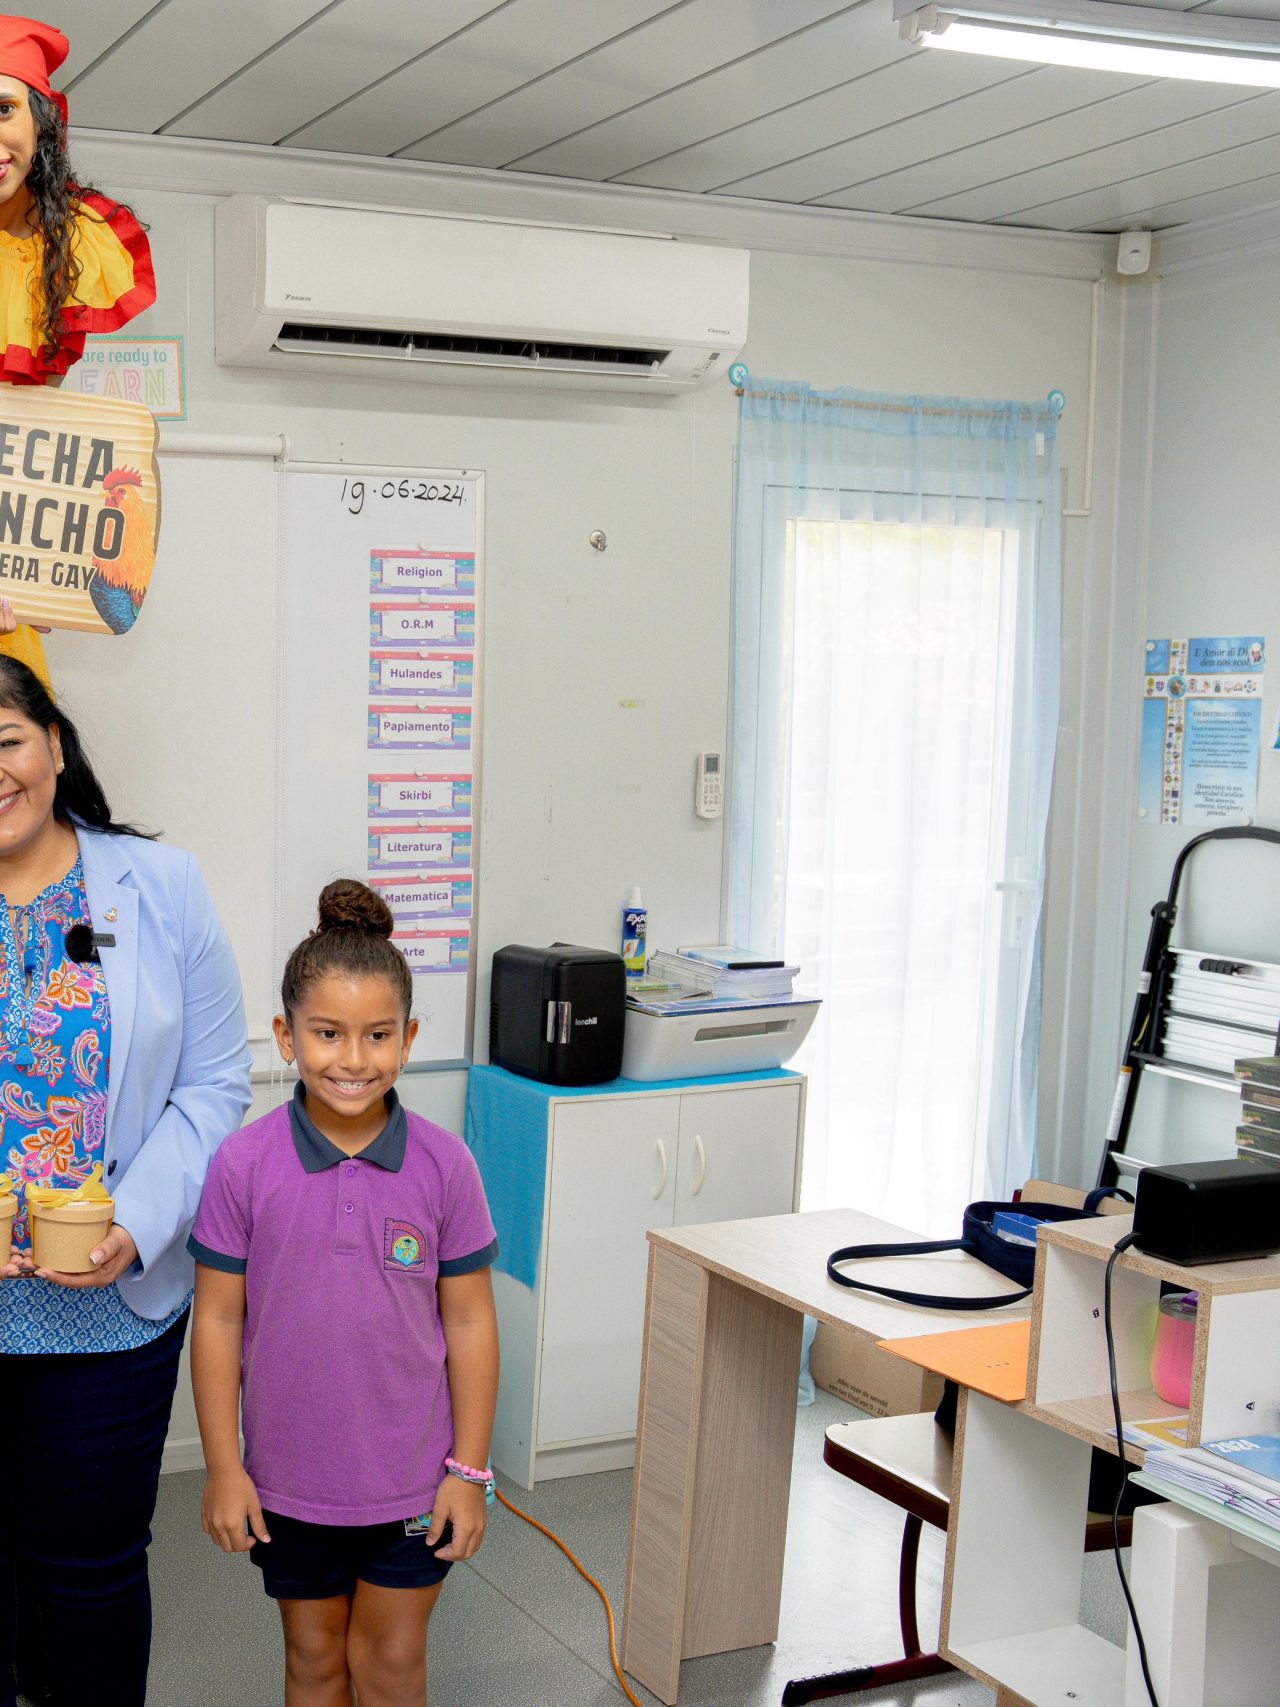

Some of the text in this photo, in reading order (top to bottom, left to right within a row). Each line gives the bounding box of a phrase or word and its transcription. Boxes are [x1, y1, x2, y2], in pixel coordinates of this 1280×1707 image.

[109, 348, 150, 367] ready
[153, 349, 167, 363] to
[51, 562, 95, 591] GAY
[397, 566, 443, 579] Religion
[401, 619, 434, 630] O.R.M
[390, 668, 442, 680] Hulandes
[383, 721, 450, 734] Papiamento
[399, 790, 432, 801] Skirbi
[387, 842, 442, 852] Literatura
[385, 891, 449, 902] Matematica
[402, 947, 425, 957] Arte
[1245, 1401, 1256, 1411] A
